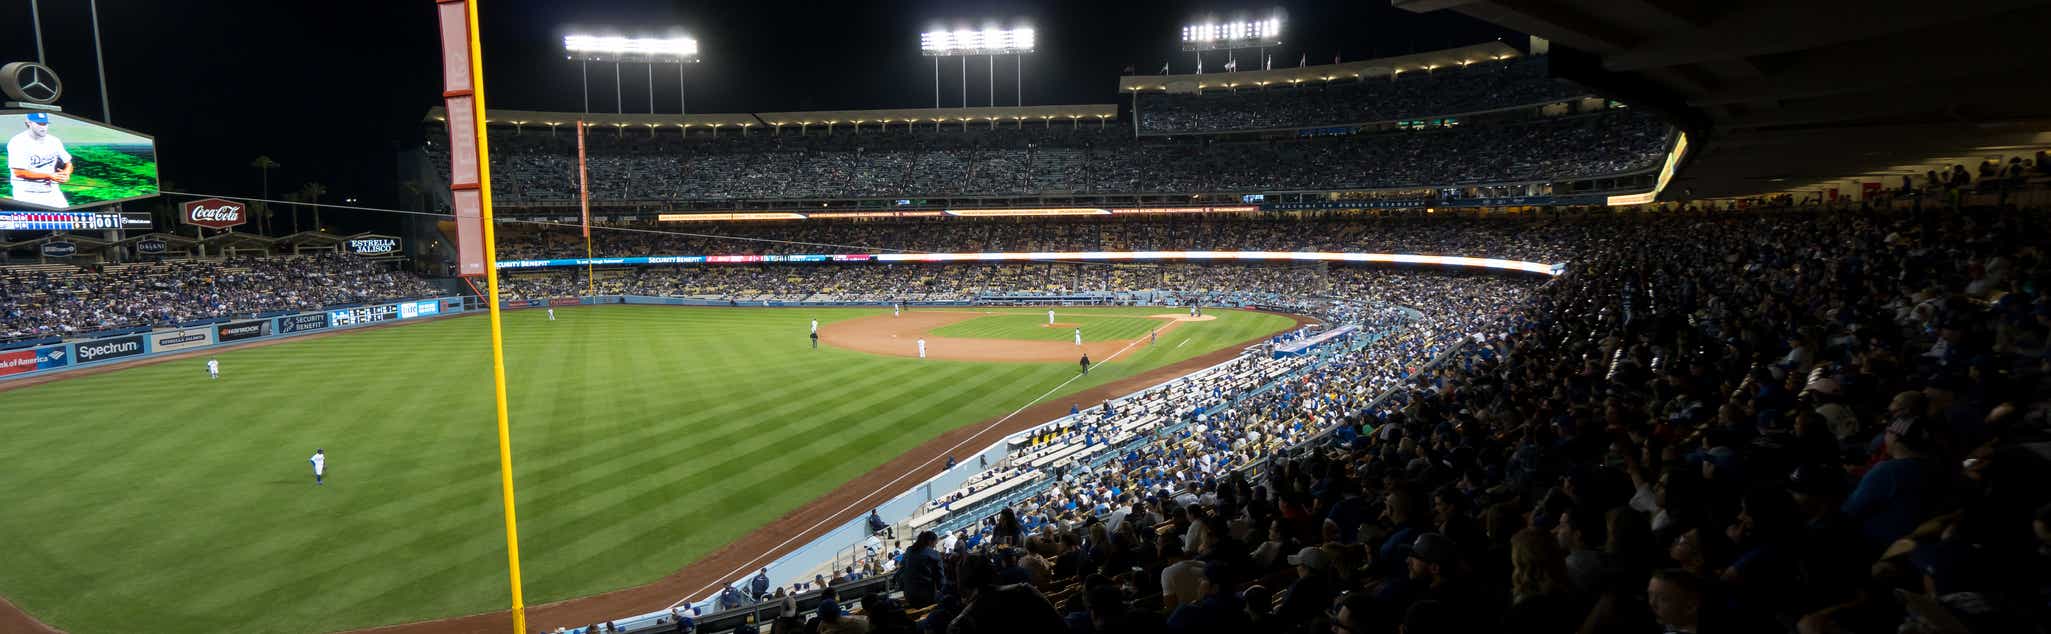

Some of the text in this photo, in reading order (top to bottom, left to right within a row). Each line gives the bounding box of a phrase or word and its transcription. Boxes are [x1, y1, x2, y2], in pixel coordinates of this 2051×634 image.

[192, 205, 241, 221] Coca-Cola
[352, 239, 396, 247] ESTRELLA
[356, 245, 392, 253] JALISCO
[295, 315, 324, 323] SECURITY
[79, 341, 137, 359] Spectrum
[18, 355, 49, 366] America
